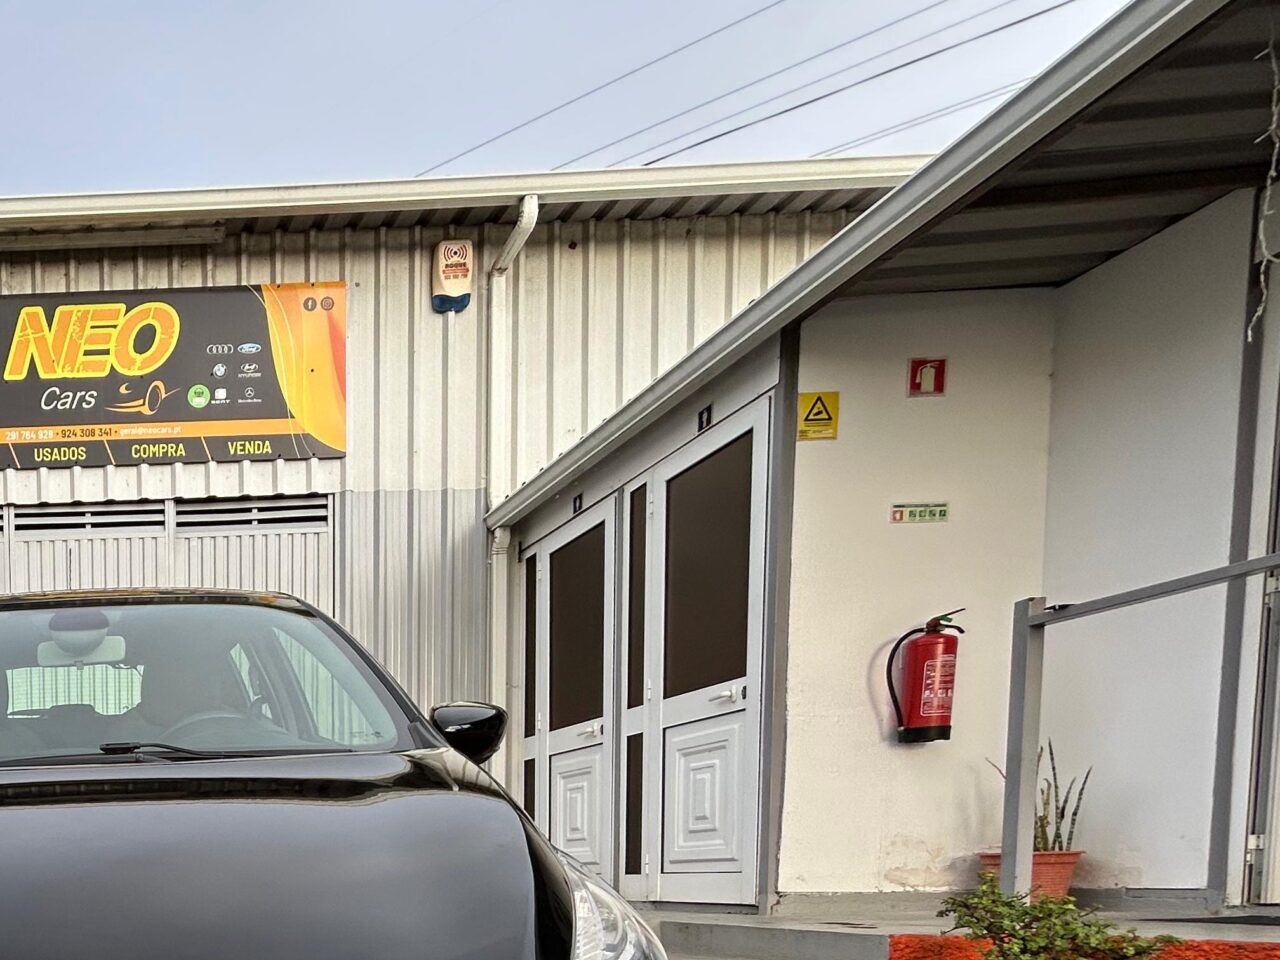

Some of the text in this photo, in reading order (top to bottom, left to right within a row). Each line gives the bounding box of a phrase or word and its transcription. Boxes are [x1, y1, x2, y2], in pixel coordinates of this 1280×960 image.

[3, 302, 180, 380] NEO
[40, 386, 97, 410] Cars
[61, 429, 77, 439] 924
[79, 428, 95, 438] 308
[98, 427, 112, 437] 341
[34, 447, 87, 462] USADOS
[131, 443, 186, 459] COMPRA
[227, 440, 272, 456] VENDA
